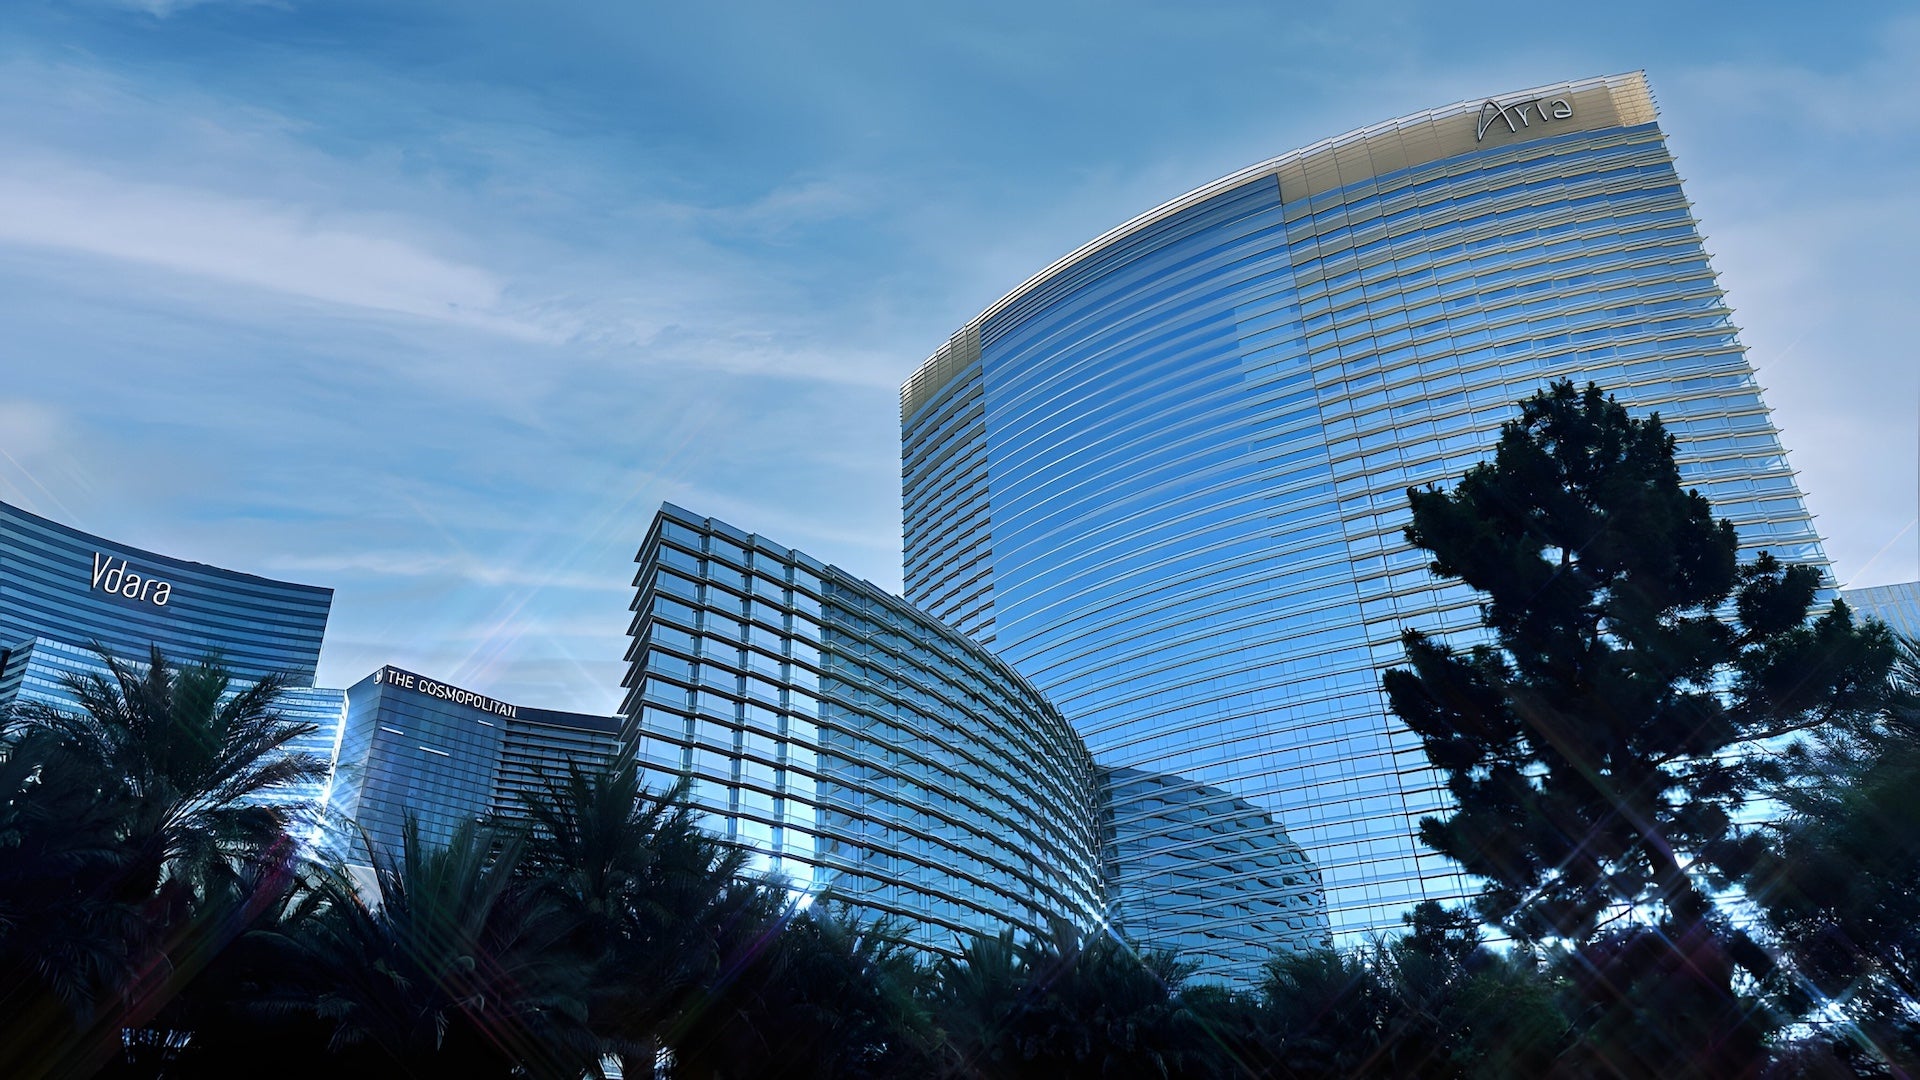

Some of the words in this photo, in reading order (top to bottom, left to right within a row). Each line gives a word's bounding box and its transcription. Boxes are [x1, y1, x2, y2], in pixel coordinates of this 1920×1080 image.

[1477, 98, 1573, 142] Aria
[91, 551, 172, 606] Vdara
[387, 669, 415, 689] THE
[418, 679, 517, 718] COSMOPOLITAN
